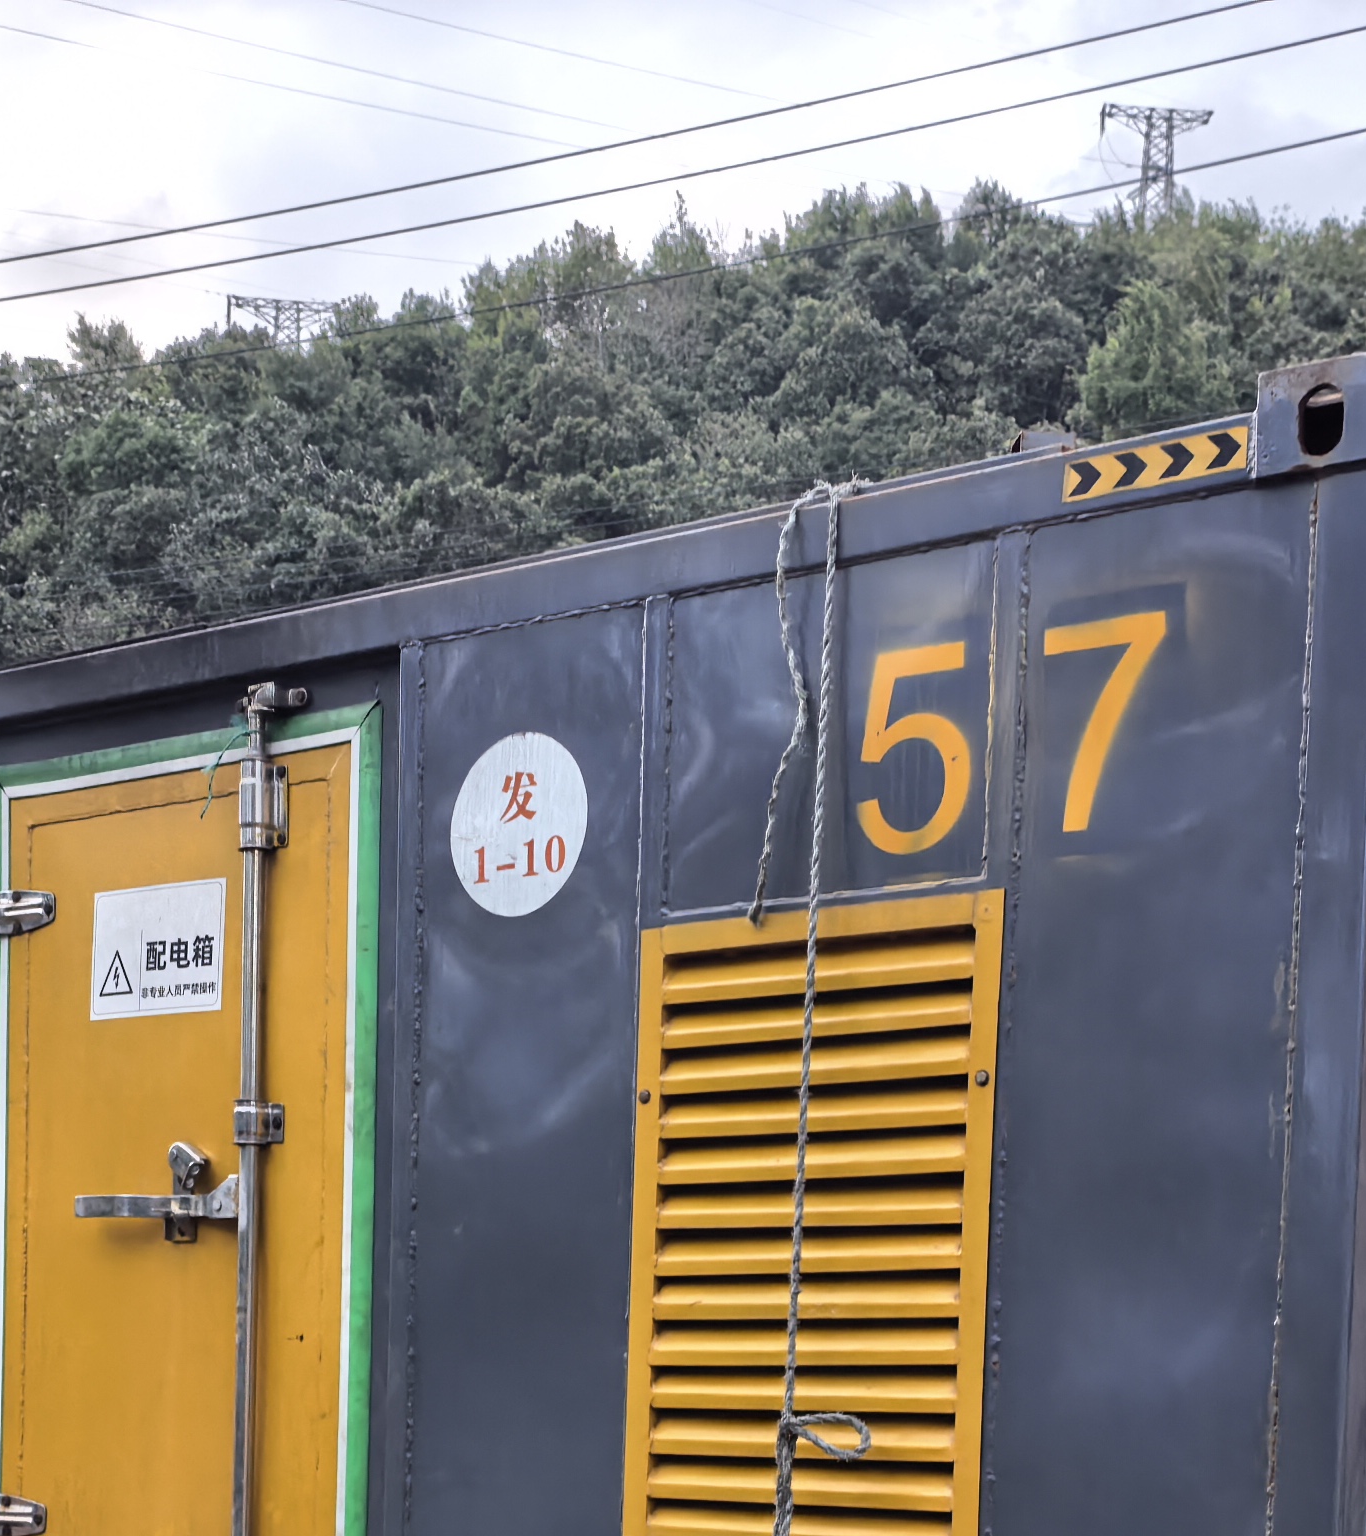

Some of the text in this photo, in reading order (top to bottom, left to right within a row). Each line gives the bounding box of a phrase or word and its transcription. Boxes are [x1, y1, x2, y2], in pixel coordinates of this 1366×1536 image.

[857, 611, 1166, 854] 57
[499, 771, 537, 824] 发
[473, 835, 566, 884] 1-10
[146, 935, 214, 971] 配电箱
[141, 982, 216, 999] 非专业人员严禁操作
